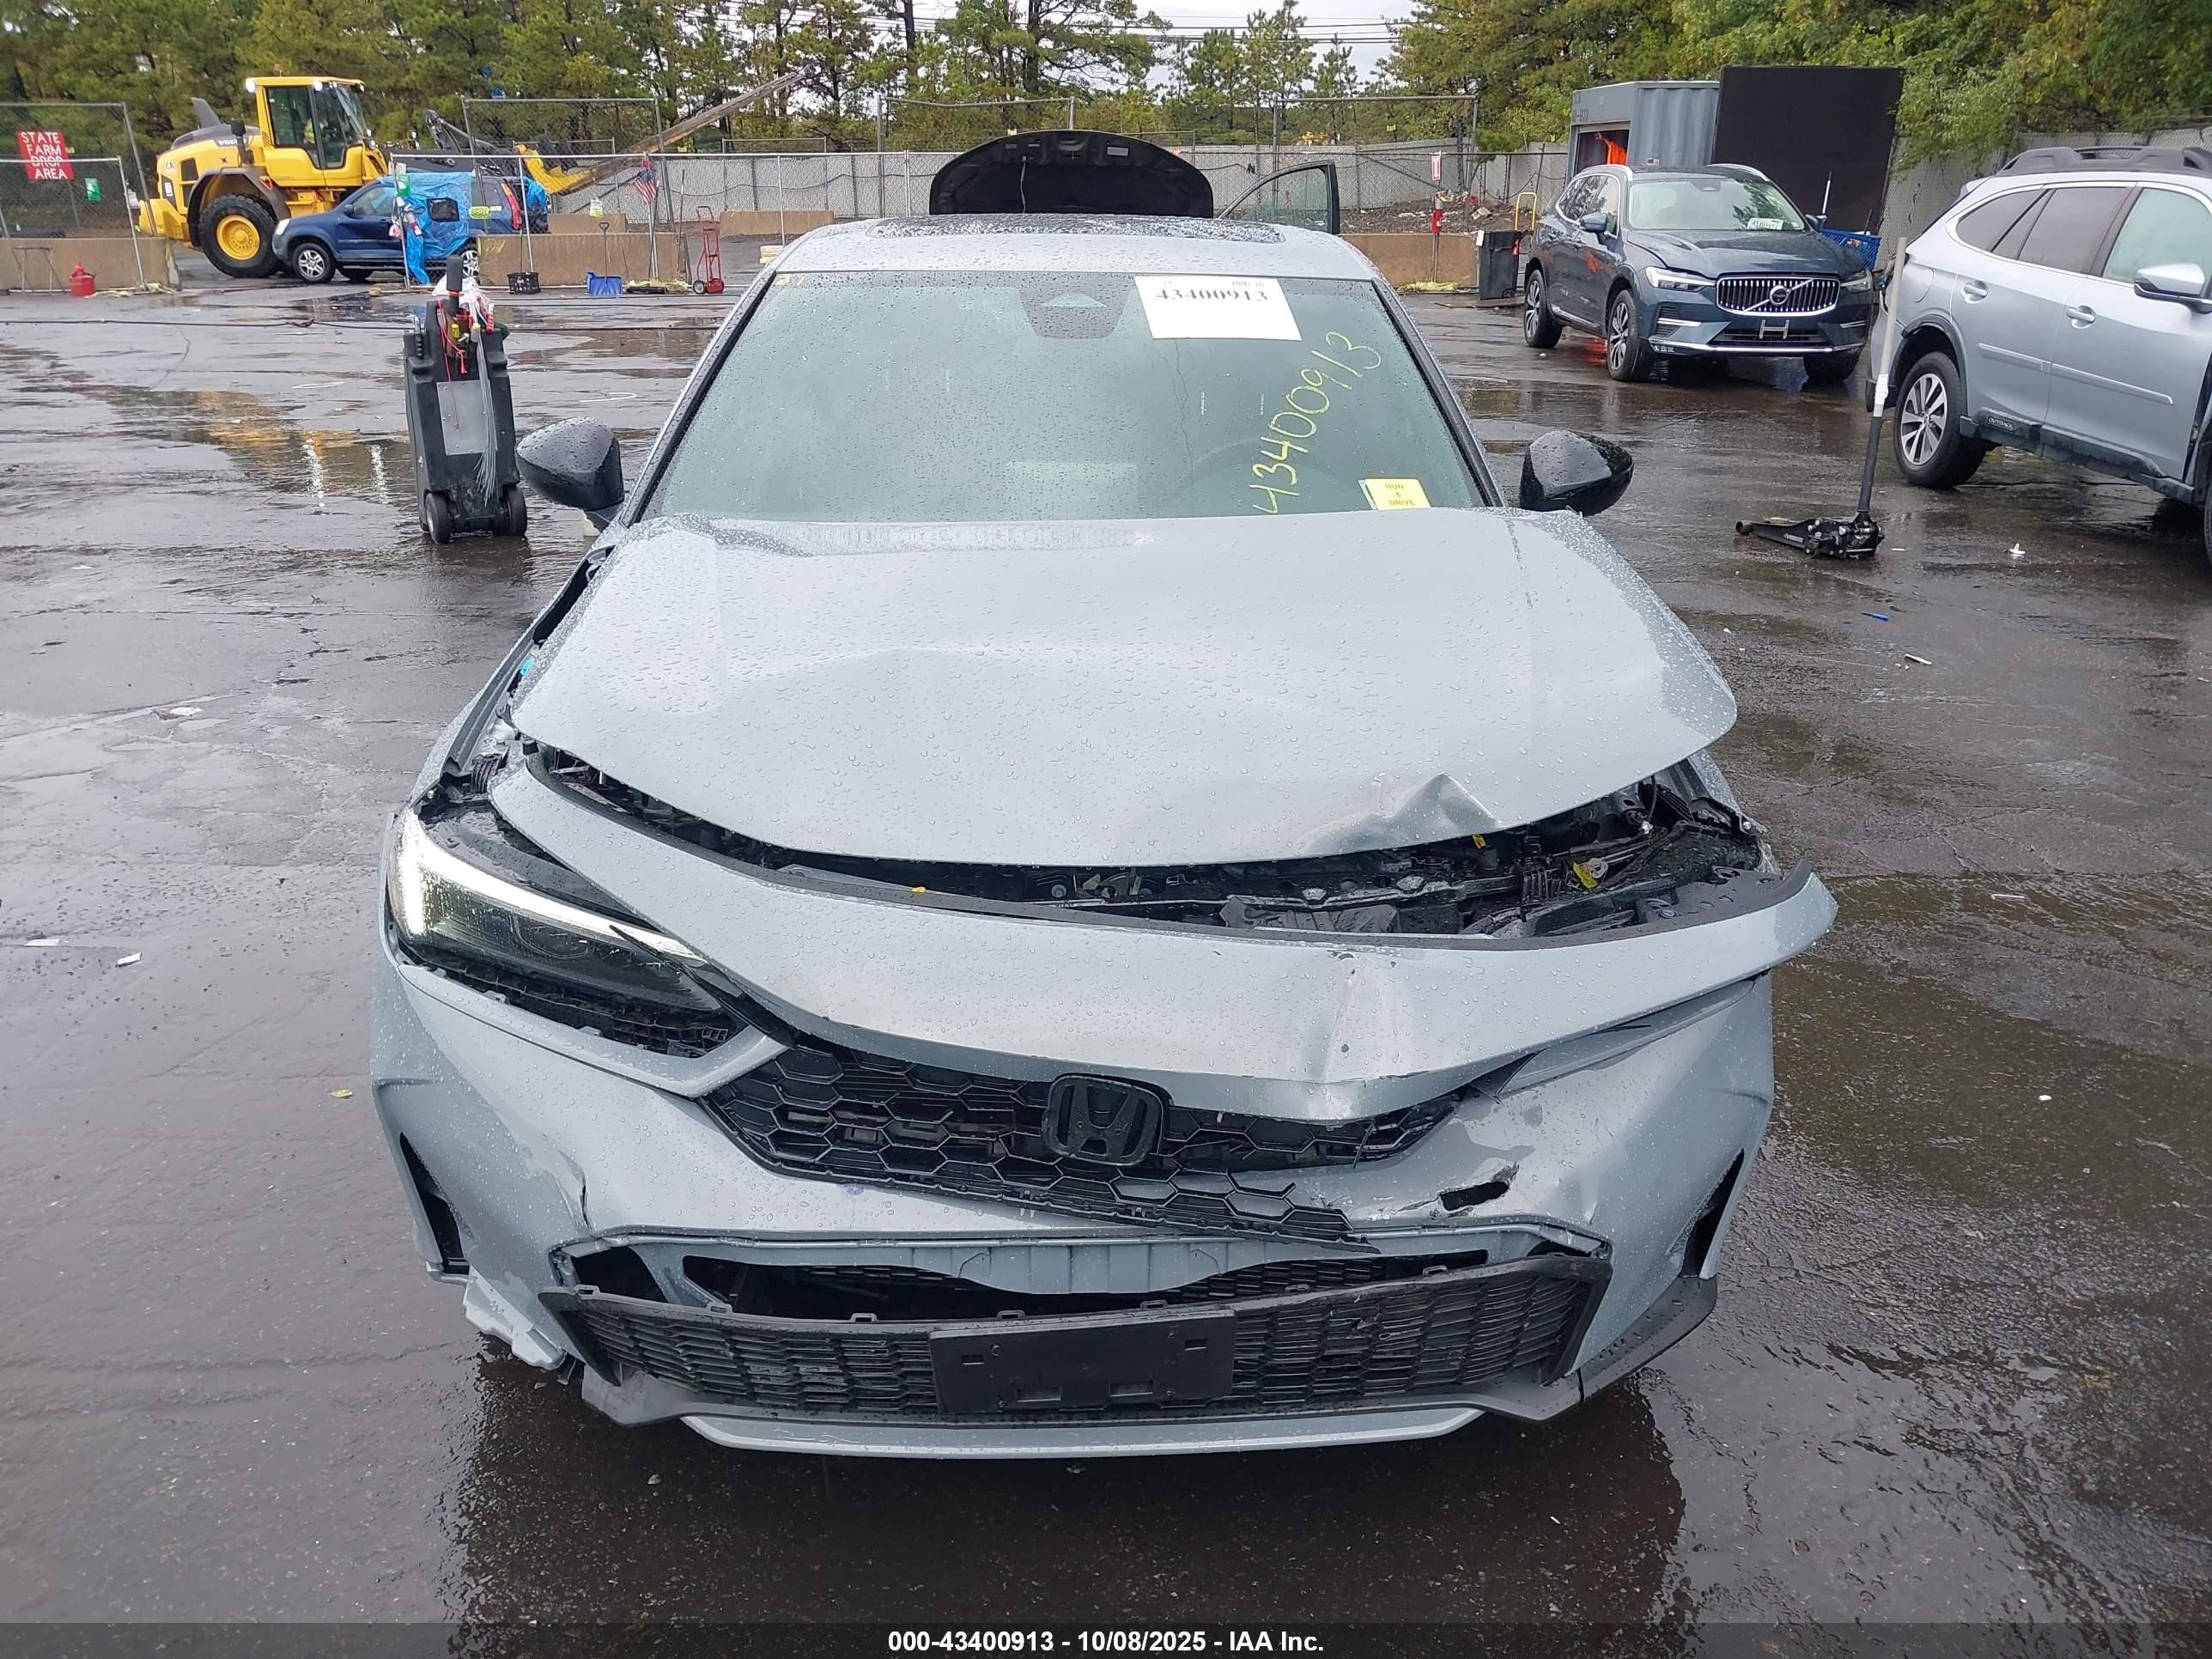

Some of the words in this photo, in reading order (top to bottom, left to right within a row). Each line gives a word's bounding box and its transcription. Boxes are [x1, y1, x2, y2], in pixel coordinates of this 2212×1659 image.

[21, 131, 60, 144] STATE
[27, 144, 62, 155] FARM
[30, 156, 63, 167] DROP
[35, 168, 68, 179] AREA
[1156, 289, 1268, 301] 43400913
[1249, 331, 1382, 514] 43400913
